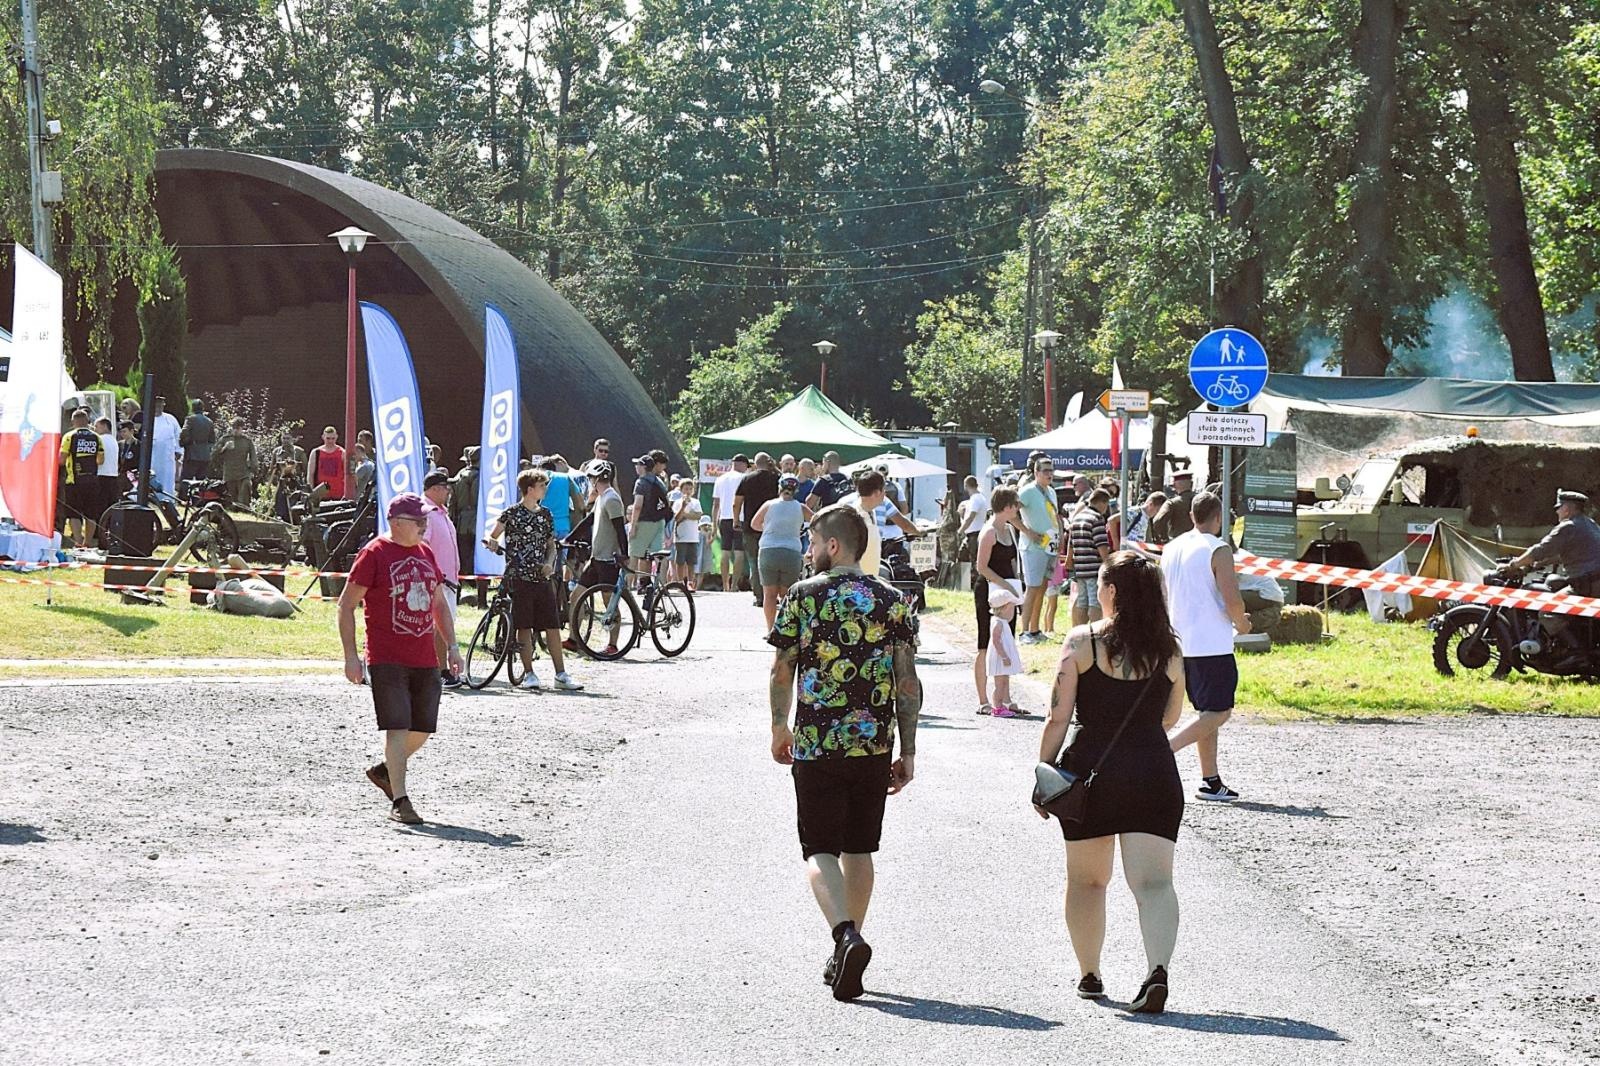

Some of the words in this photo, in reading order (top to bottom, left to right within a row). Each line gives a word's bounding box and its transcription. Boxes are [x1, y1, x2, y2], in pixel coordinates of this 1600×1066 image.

[1205, 415, 1217, 423] Nie
[1221, 416, 1249, 425] dotyczy
[1220, 425, 1256, 434] gminnych
[1077, 454, 1113, 466] Godów
